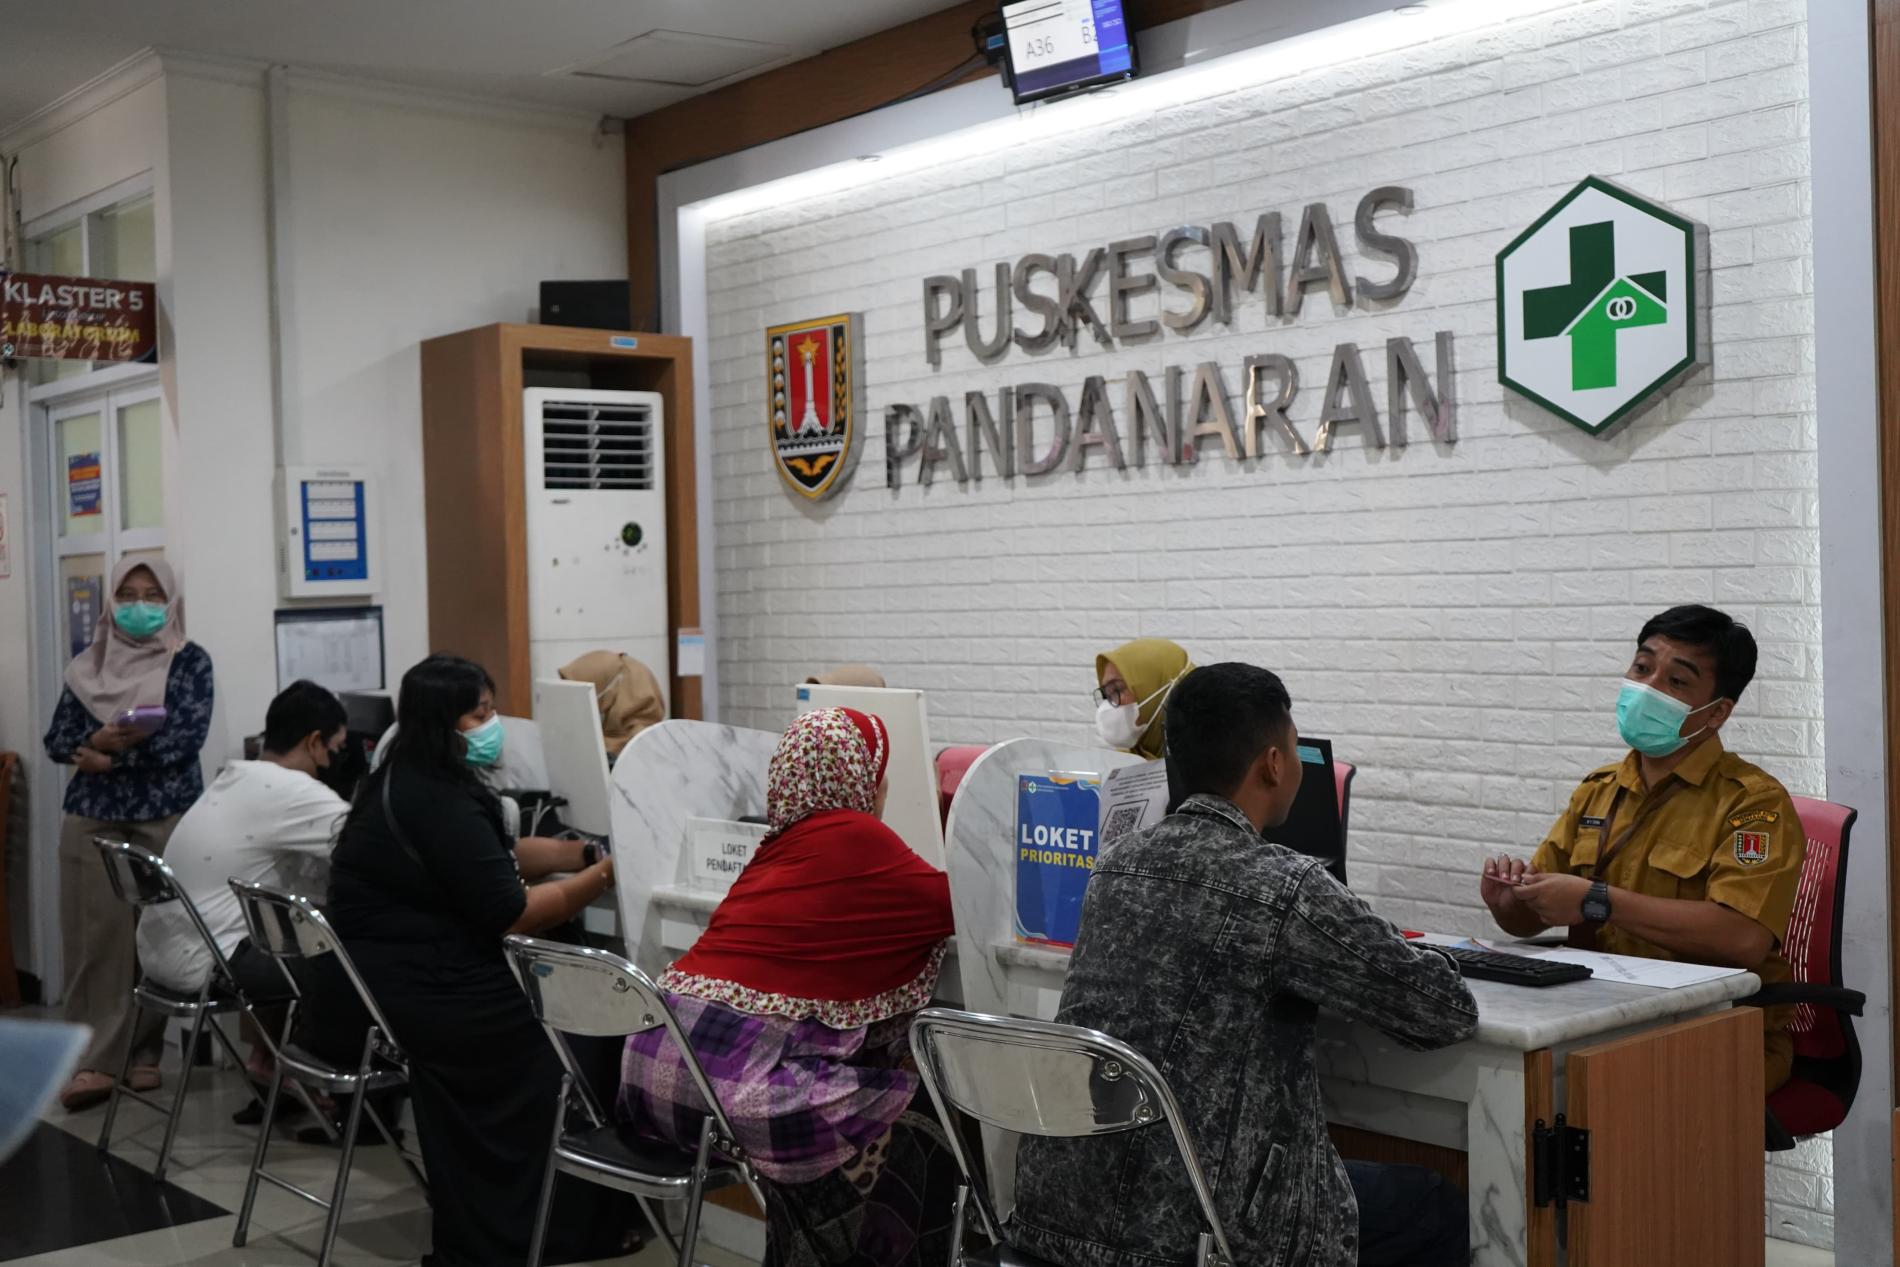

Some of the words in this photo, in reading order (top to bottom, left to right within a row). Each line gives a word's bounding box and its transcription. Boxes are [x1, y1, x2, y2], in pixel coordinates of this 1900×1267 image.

[1027, 36, 1054, 57] A36
[923, 186, 1417, 366] PUSKESMAS
[4, 282, 122, 309] KLASTER
[129, 290, 143, 311] 5
[885, 331, 1455, 488] PANDANARAN
[722, 843, 747, 856] LOKET
[1021, 823, 1094, 851] LOKET
[1021, 848, 1095, 869] PRIORITAS
